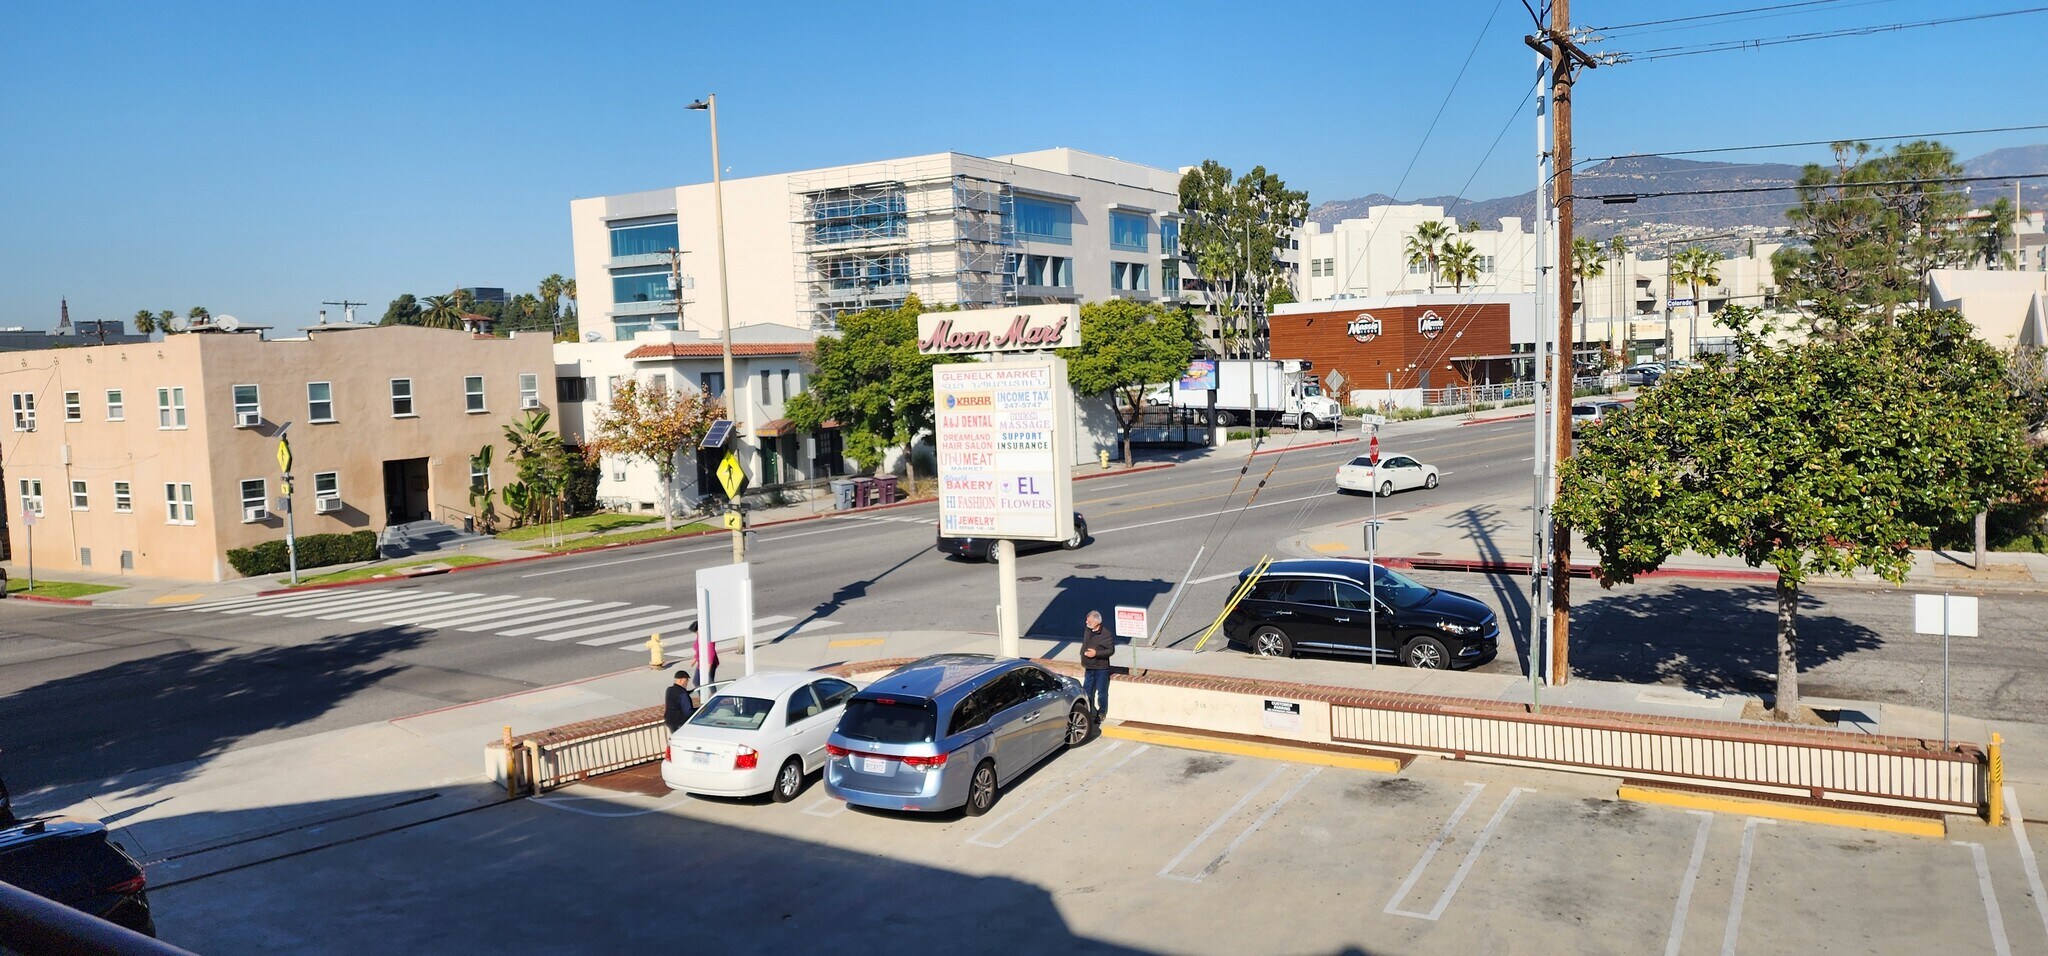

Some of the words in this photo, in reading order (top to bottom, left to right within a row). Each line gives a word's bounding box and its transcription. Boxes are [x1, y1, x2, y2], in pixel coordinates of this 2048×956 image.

[918, 320, 990, 350] Moon
[993, 314, 1067, 347] Mart
[942, 373, 993, 382] GLENELK
[996, 370, 1044, 379] MARKET
[997, 391, 1030, 403] INCOME
[1033, 390, 1049, 401] TAX
[943, 416, 959, 428] A&J
[961, 415, 993, 427] DENTAL
[999, 420, 1050, 430] MASSAGE
[943, 433, 990, 441] DREAMLAND
[1002, 432, 1042, 440] SUPPORT
[943, 442, 964, 450] HAIR
[965, 441, 993, 450] SALON
[997, 442, 1048, 450] INSURANCE
[963, 453, 993, 466] MEAT
[946, 481, 993, 490] BAKERY
[1018, 477, 1039, 494] EL
[946, 496, 956, 509] HI
[958, 496, 996, 510] FASHION
[1001, 498, 1052, 509] FLOWERS
[958, 516, 994, 526] JEWELRY
